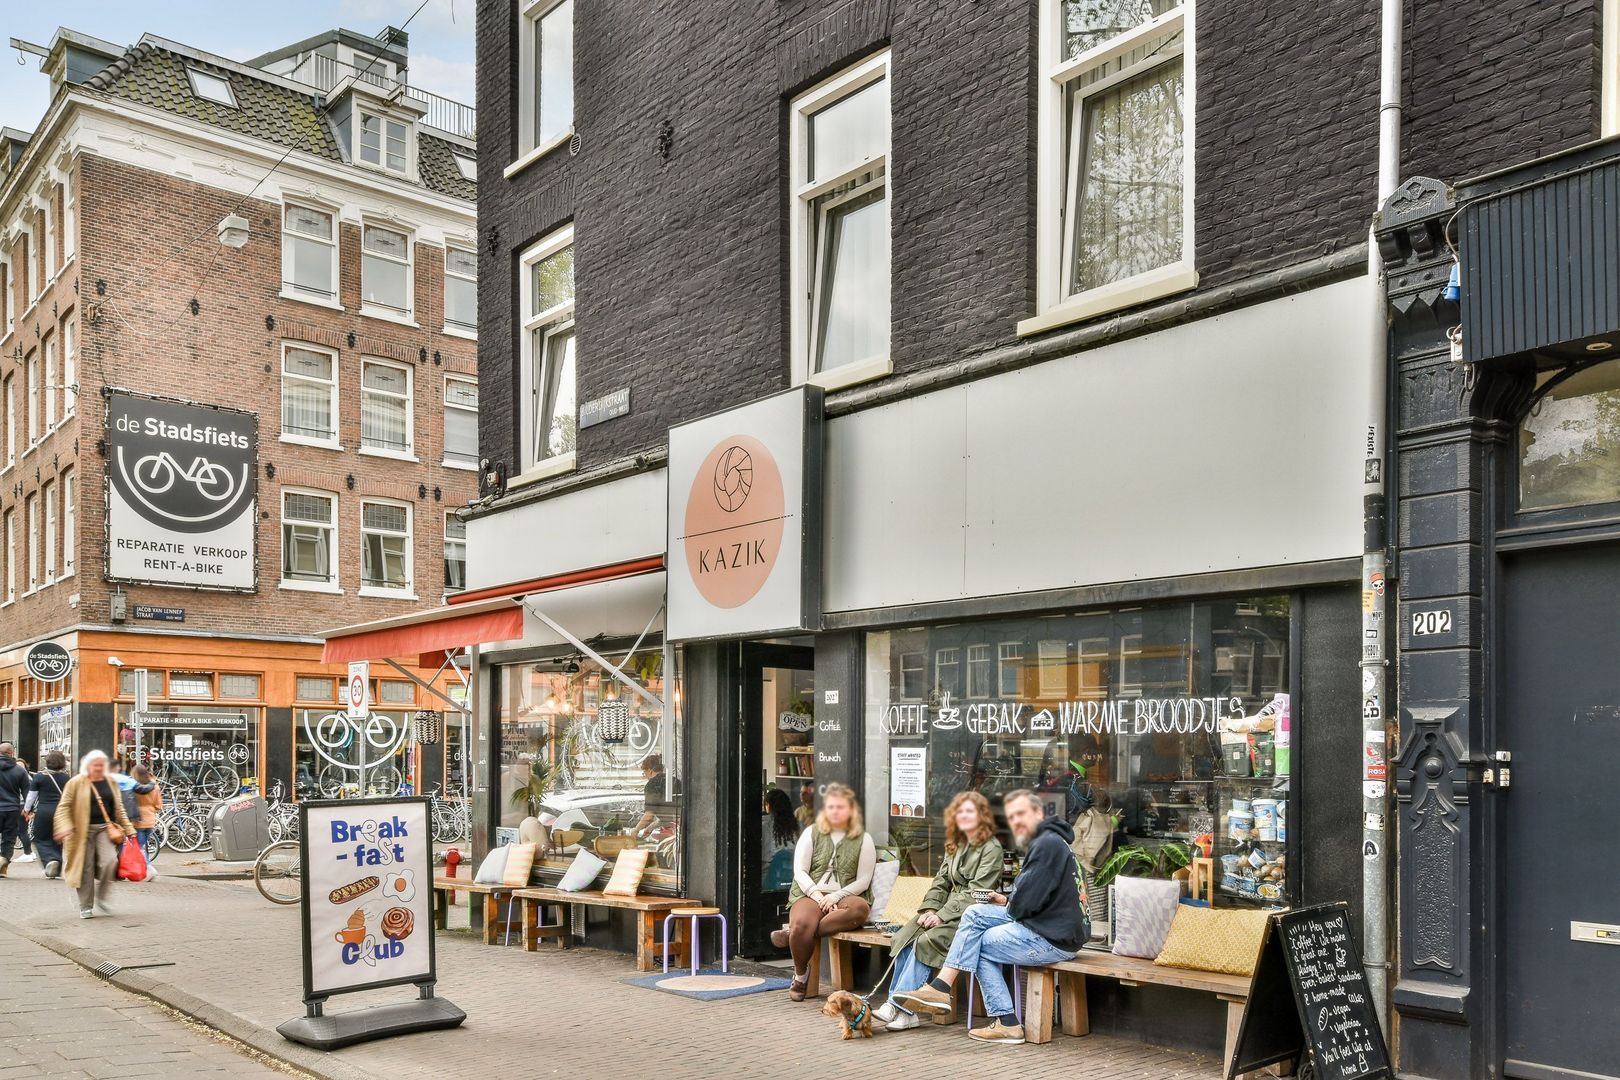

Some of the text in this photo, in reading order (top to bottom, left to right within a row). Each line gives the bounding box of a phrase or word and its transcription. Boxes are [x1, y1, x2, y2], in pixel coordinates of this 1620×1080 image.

[116, 414, 249, 450] de Stadsfiets
[117, 538, 248, 560] REPARATIE VERKOOP
[700, 538, 765, 574] KAZIK
[144, 558, 224, 574] RENT-A-BIKE
[1414, 610, 1450, 635] 202
[354, 685, 361, 696] 30
[783, 716, 807, 728] OPEN
[880, 696, 1246, 735] KOFFIE GEBAK WARME BROODJES
[150, 748, 224, 761] Stadsfiets
[330, 816, 408, 844] Break
[1308, 920, 1337, 938] Hey you
[1319, 936, 1330, 946] We
[1330, 932, 1346, 943] make
[342, 934, 404, 967] Club
[1300, 948, 1316, 966] great
[1324, 962, 1336, 975] Try
[1339, 1045, 1352, 1060] feel
[1352, 1041, 1363, 1053] like
[1364, 1040, 1373, 1051] at
[1340, 1064, 1358, 1076] home
